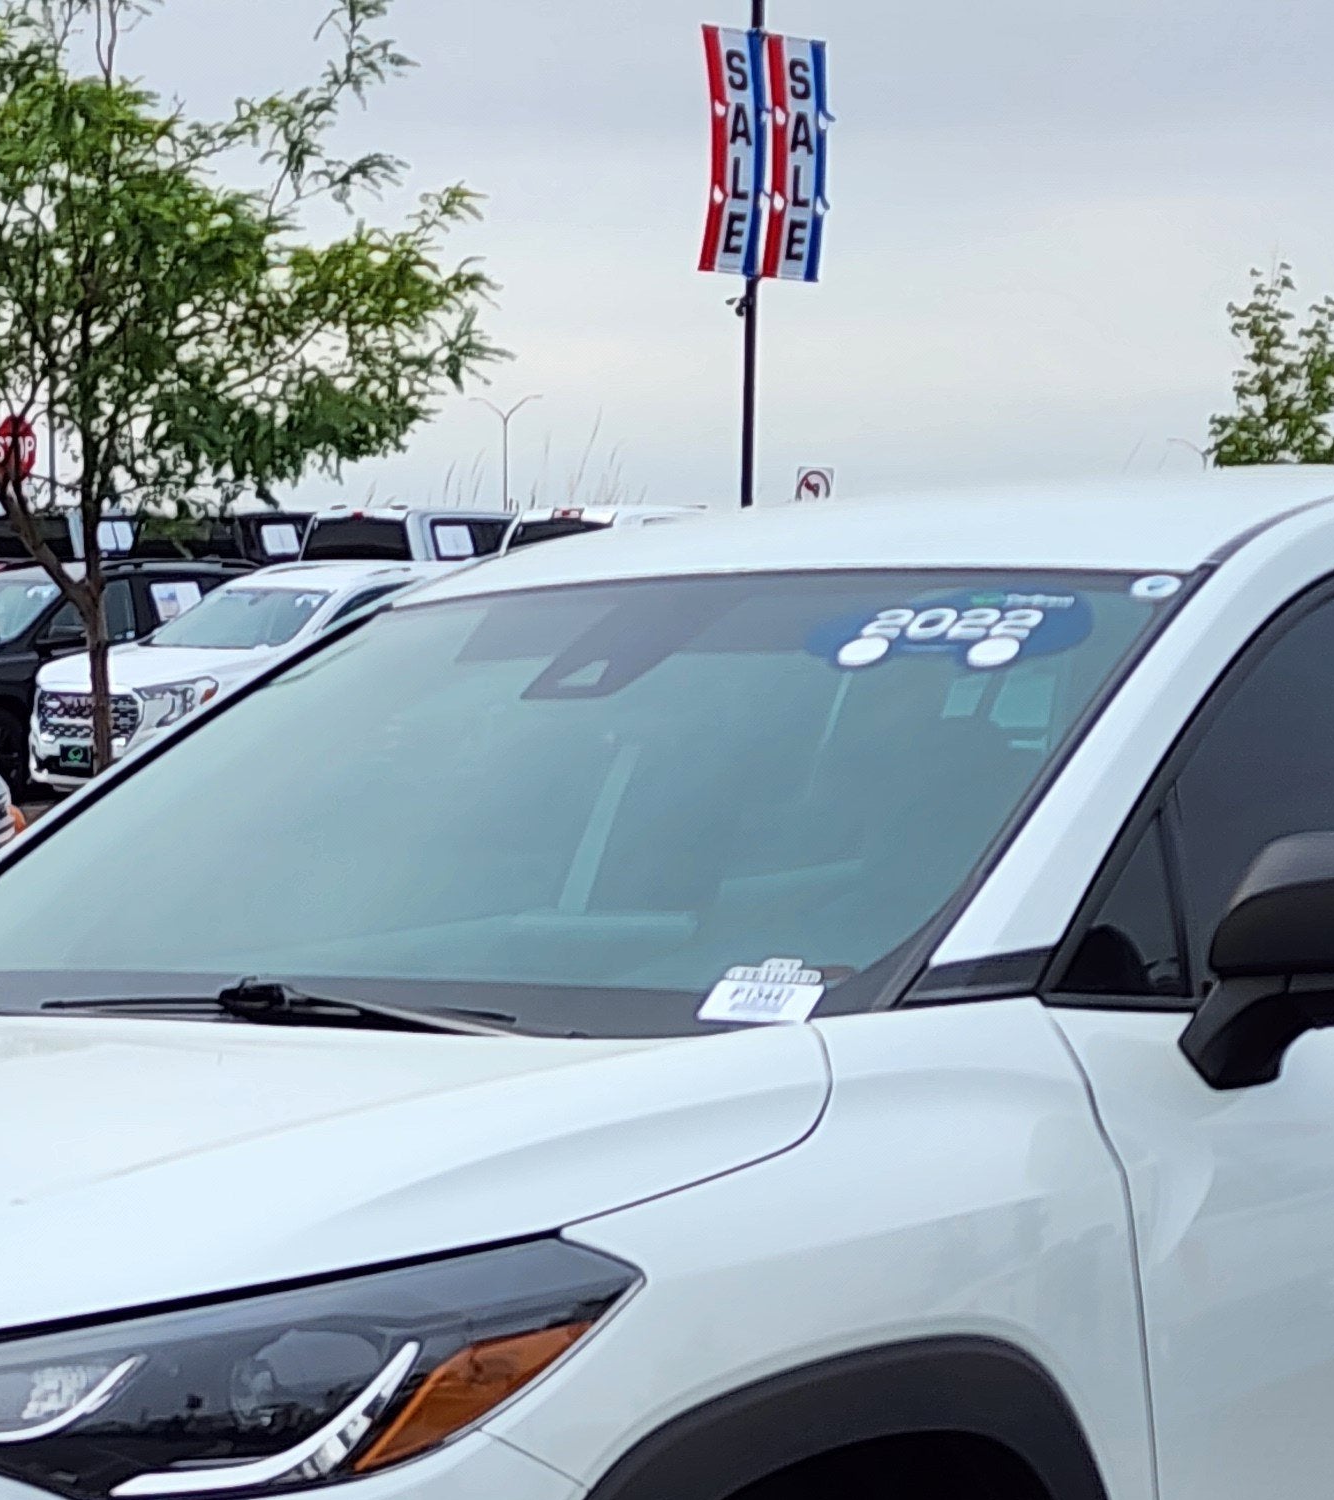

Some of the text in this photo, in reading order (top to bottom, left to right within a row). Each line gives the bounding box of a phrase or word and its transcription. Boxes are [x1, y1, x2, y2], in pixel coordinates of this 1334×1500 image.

[722, 49, 752, 254] SALE
[785, 57, 814, 261] SALE
[861, 608, 1043, 640] 2022
